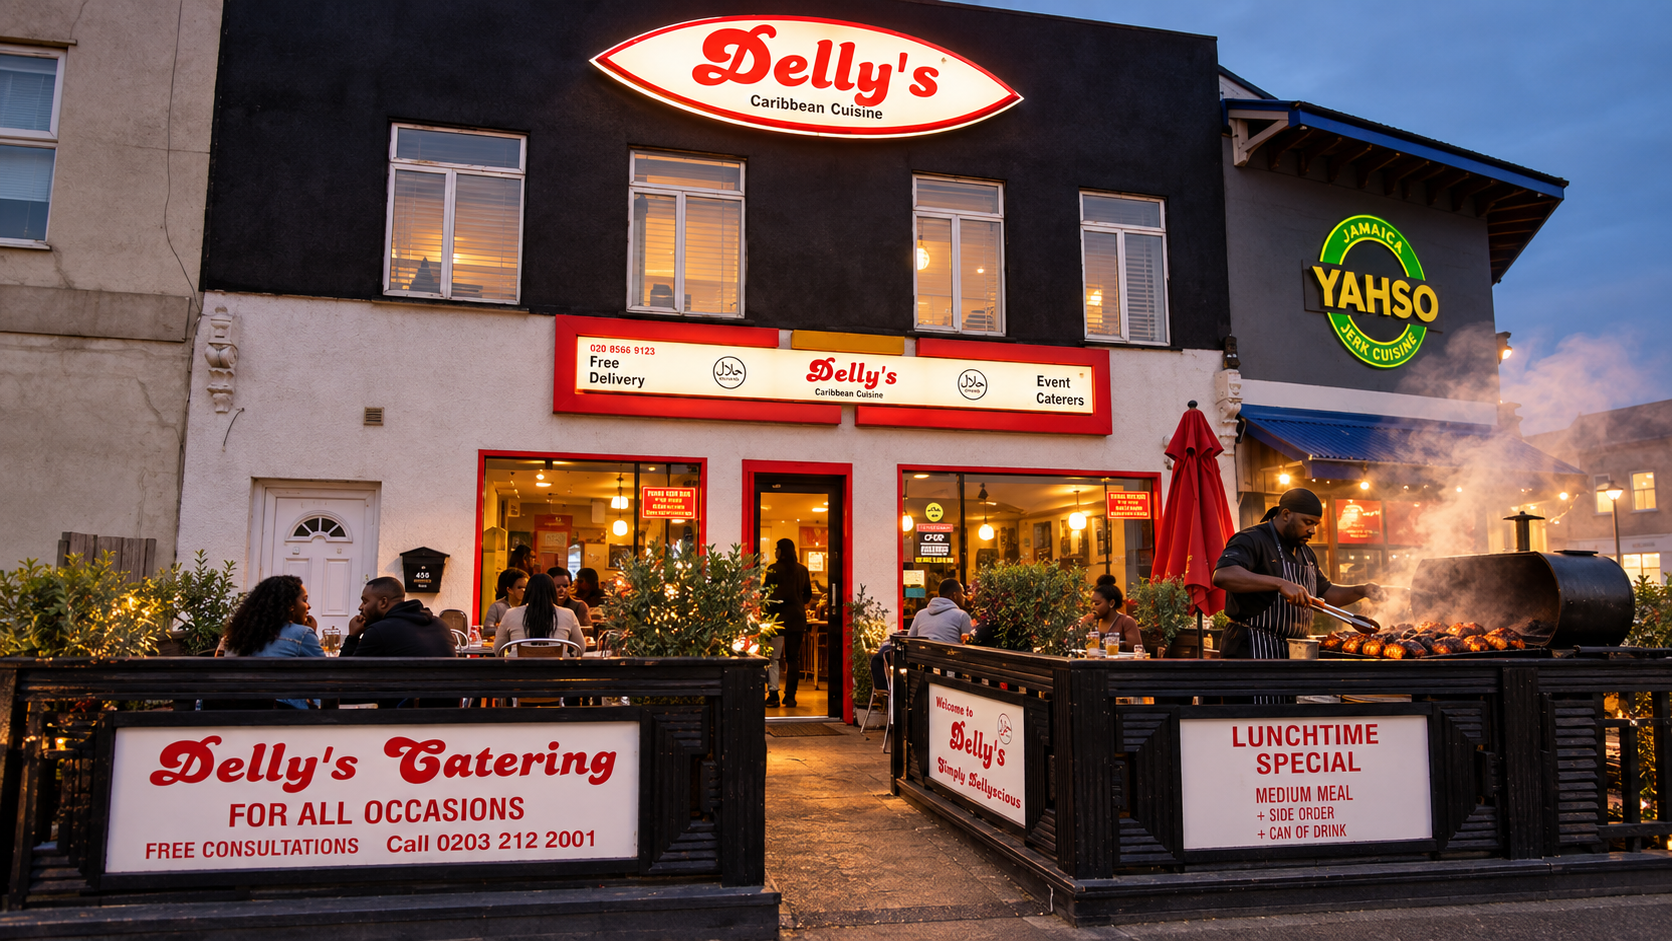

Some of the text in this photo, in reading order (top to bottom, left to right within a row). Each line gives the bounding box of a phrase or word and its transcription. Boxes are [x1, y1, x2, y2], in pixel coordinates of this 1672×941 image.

[692, 24, 939, 107] Delly's
[750, 94, 883, 120] Caribbean Cuisine
[1343, 222, 1403, 254] JAMAICA
[1312, 265, 1439, 322] YAHSO
[590, 344, 655, 355] 020 8566 9123
[1340, 324, 1417, 361] JERK CUISINE
[590, 355, 619, 368] Free
[806, 357, 897, 389] Delly's
[589, 372, 645, 388] Delivery
[1036, 375, 1071, 389] Event
[815, 388, 883, 399] Caribbean Cuisine
[1036, 392, 1084, 406] Caterers
[936, 696, 973, 717] Welcome to
[950, 721, 1005, 769] Delly's
[1232, 724, 1379, 748] LUNCHTIME
[149, 735, 617, 794] Delly's Catering
[1256, 751, 1361, 774] SPECIAL
[938, 756, 1021, 809] Simply Dellyscious
[1256, 785, 1353, 803] MEDIUM MEAL
[229, 797, 525, 828] FOR ALL OCCASIONS
[1269, 808, 1294, 822] SIDE
[1298, 806, 1334, 820] ORDER
[1269, 826, 1291, 840] CAN
[1295, 825, 1309, 839] OF
[1313, 824, 1347, 838] DRINK
[146, 830, 596, 860] FREE CONSULTATIONS Call 0203 212 2001
